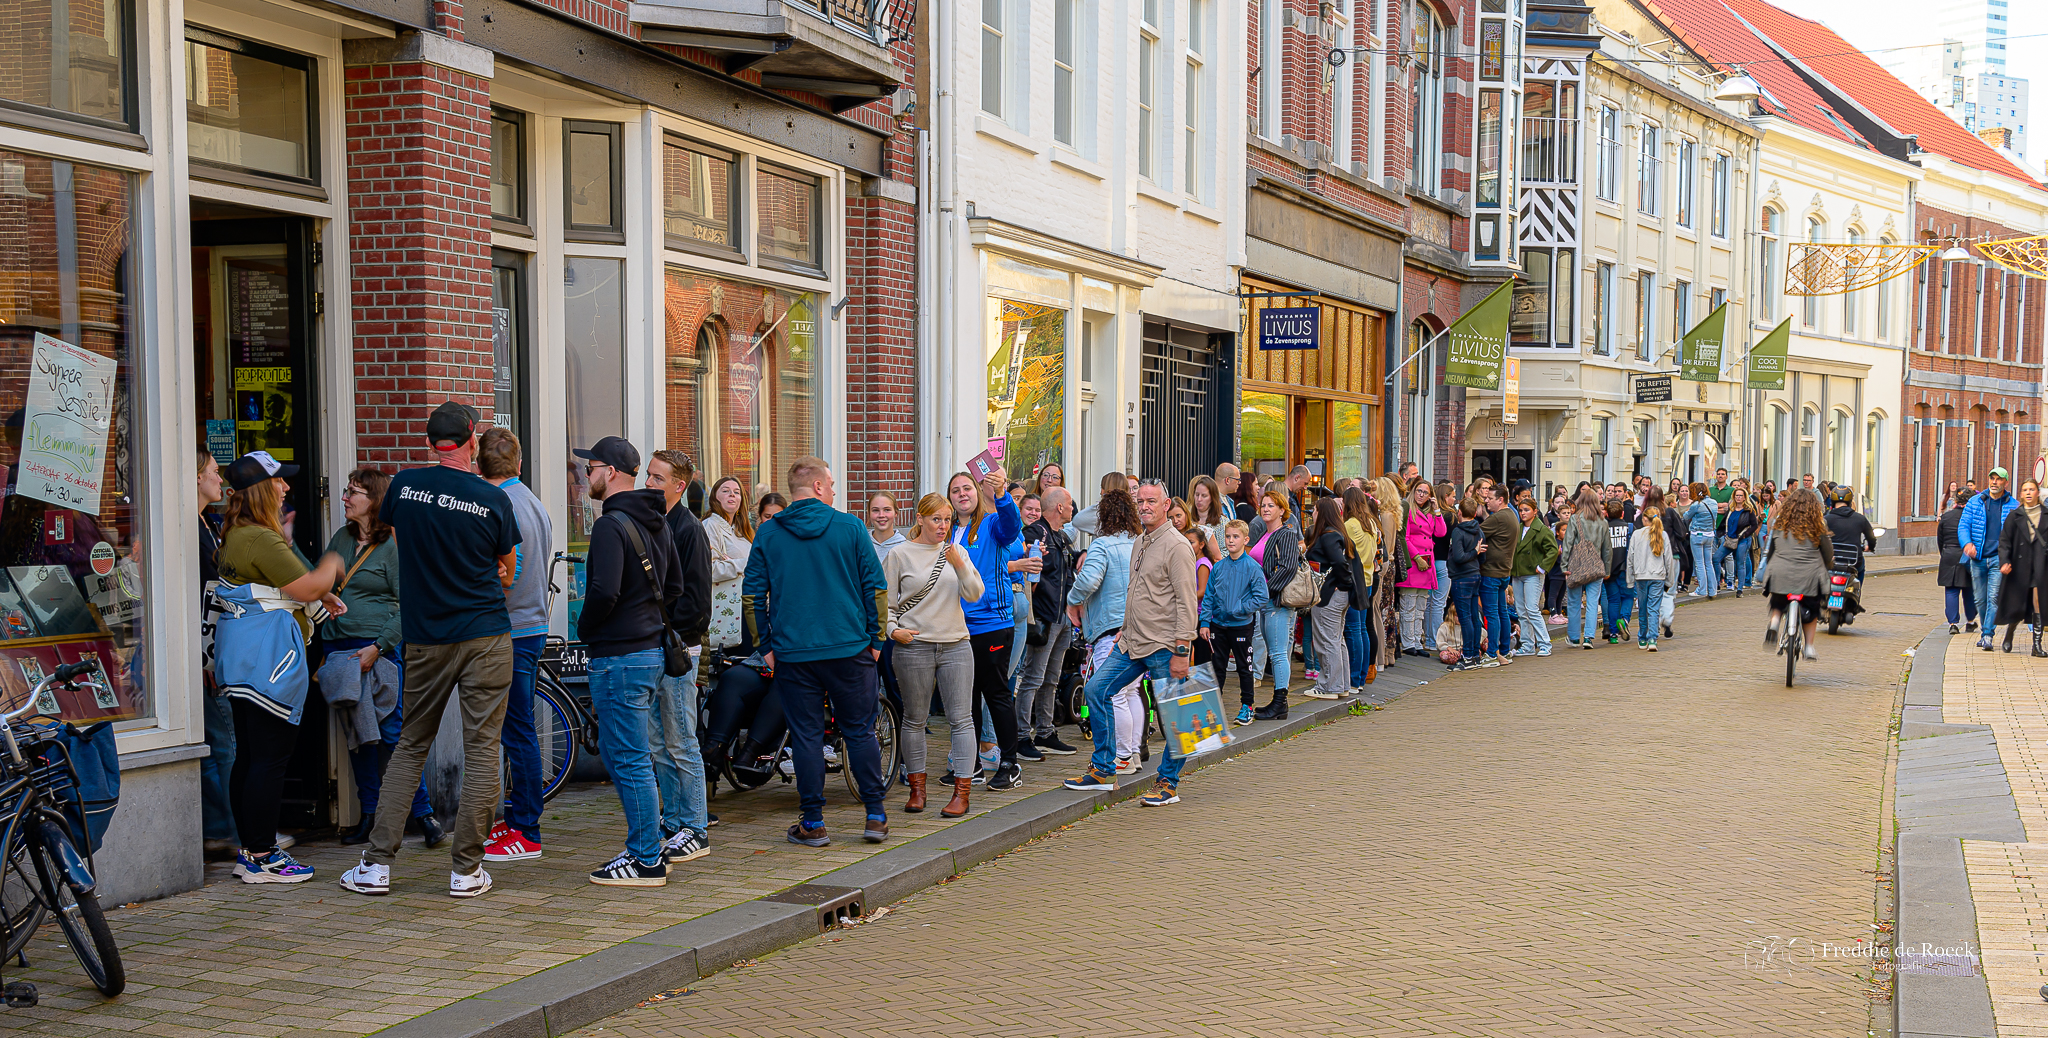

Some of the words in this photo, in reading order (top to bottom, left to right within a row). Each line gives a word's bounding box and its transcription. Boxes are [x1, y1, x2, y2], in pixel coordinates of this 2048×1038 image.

[1266, 320, 1312, 336] LIVIUS
[1454, 333, 1502, 342] BOEKHANDEL
[1451, 340, 1500, 359] LIVIUS
[1460, 357, 1498, 369] Zevensprong
[236, 369, 291, 382] POPRONDE
[64, 473, 73, 483] 26
[42, 482, 70, 501] 14:30
[400, 486, 434, 504] Arctic
[438, 494, 490, 518] Thunder
